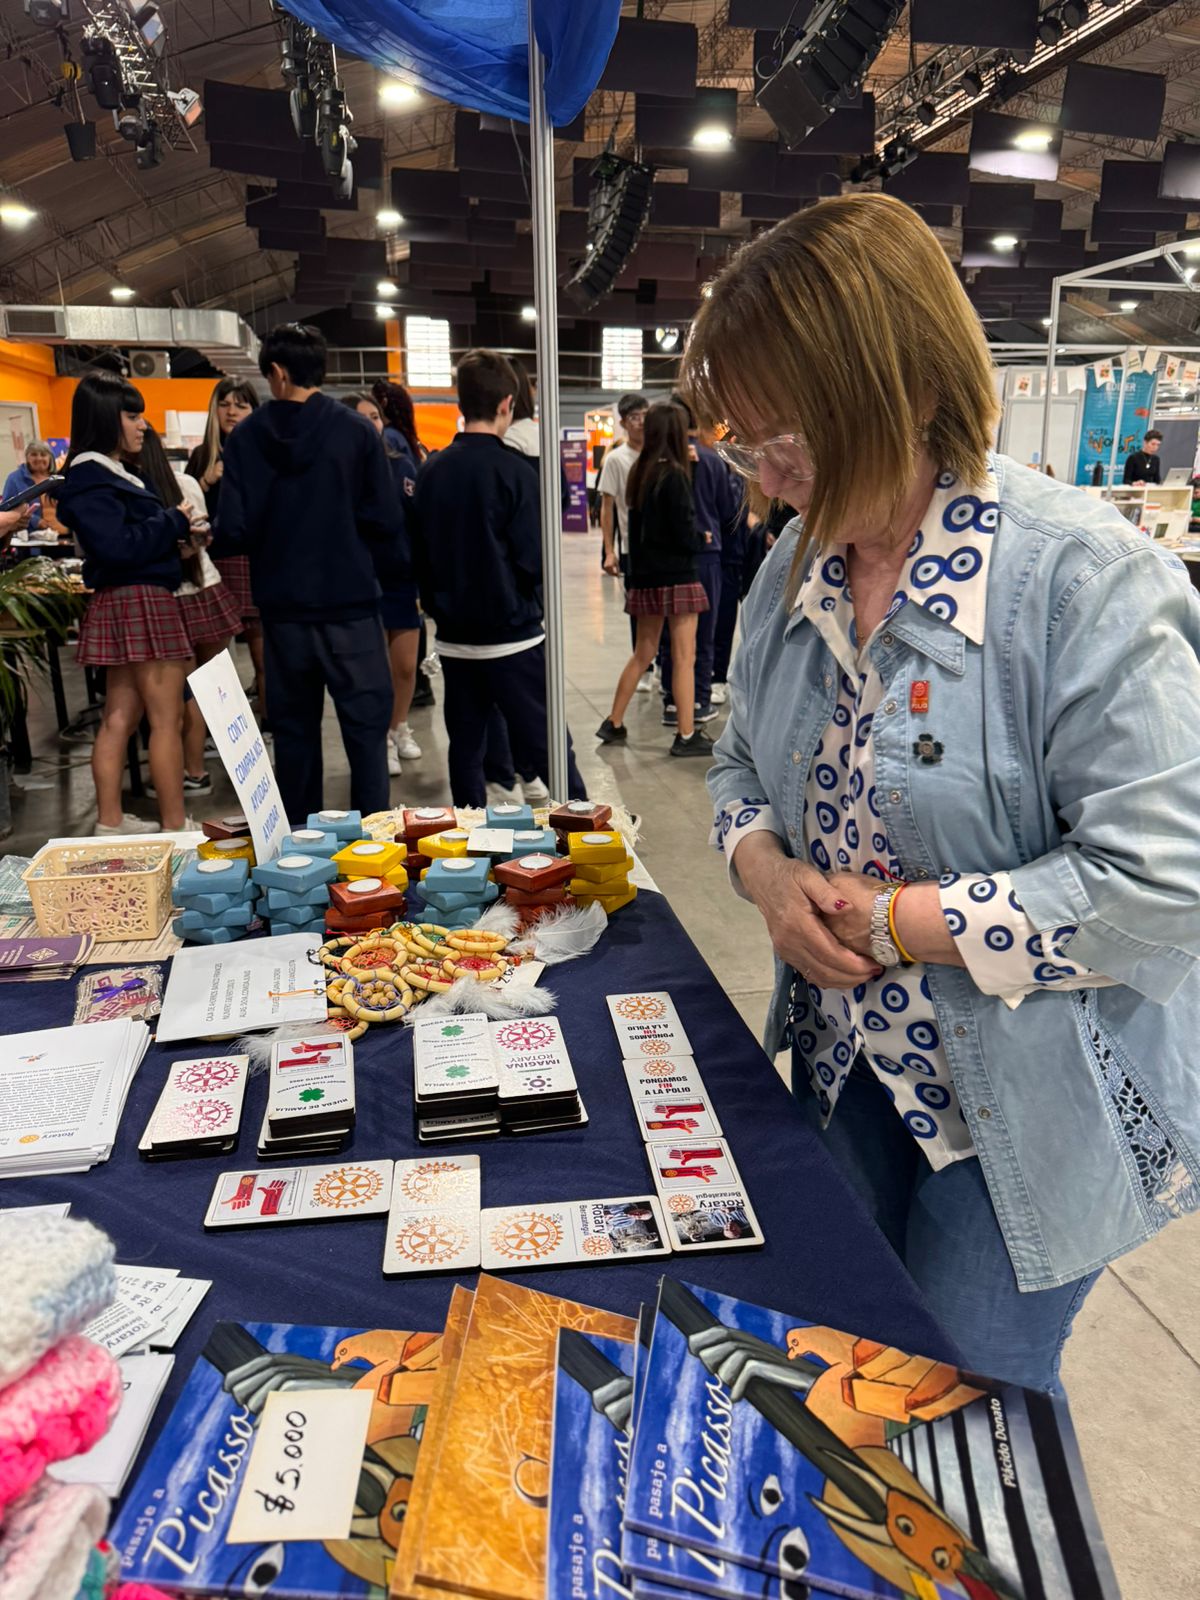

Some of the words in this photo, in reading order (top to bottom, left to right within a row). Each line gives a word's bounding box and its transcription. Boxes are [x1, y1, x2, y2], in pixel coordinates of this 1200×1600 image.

[227, 719, 240, 744] CON
[239, 712, 248, 736] TU
[234, 749, 258, 785] COMPRA
[250, 782, 266, 814] AYUDAS
[262, 805, 280, 843] AYUDAR
[506, 1059, 560, 1069] IMAGINA
[510, 1054, 554, 1062] ROTARY
[639, 1076, 688, 1084] PONGAMOS
[644, 1088, 652, 1096] A
[666, 1086, 691, 1094] POLIO
[322, 1098, 348, 1108] RUEDA
[696, 1192, 742, 1200] Berazategui
[699, 1198, 746, 1210] Rotary
[579, 1204, 590, 1236] Berazategui
[592, 1204, 606, 1235] Rotary
[106, 1320, 151, 1349] Rotary
[990, 1398, 1008, 1442] Donato
[657, 1443, 668, 1453] a
[670, 1372, 733, 1540] Picasso
[997, 1442, 1017, 1488] Plácido
[142, 1404, 255, 1575] Picasso
[649, 1459, 668, 1520] pasaje
[120, 1506, 157, 1568] pasaje
[152, 1488, 165, 1500] a
[572, 1514, 584, 1525] a
[568, 1531, 588, 1600] pasaje
